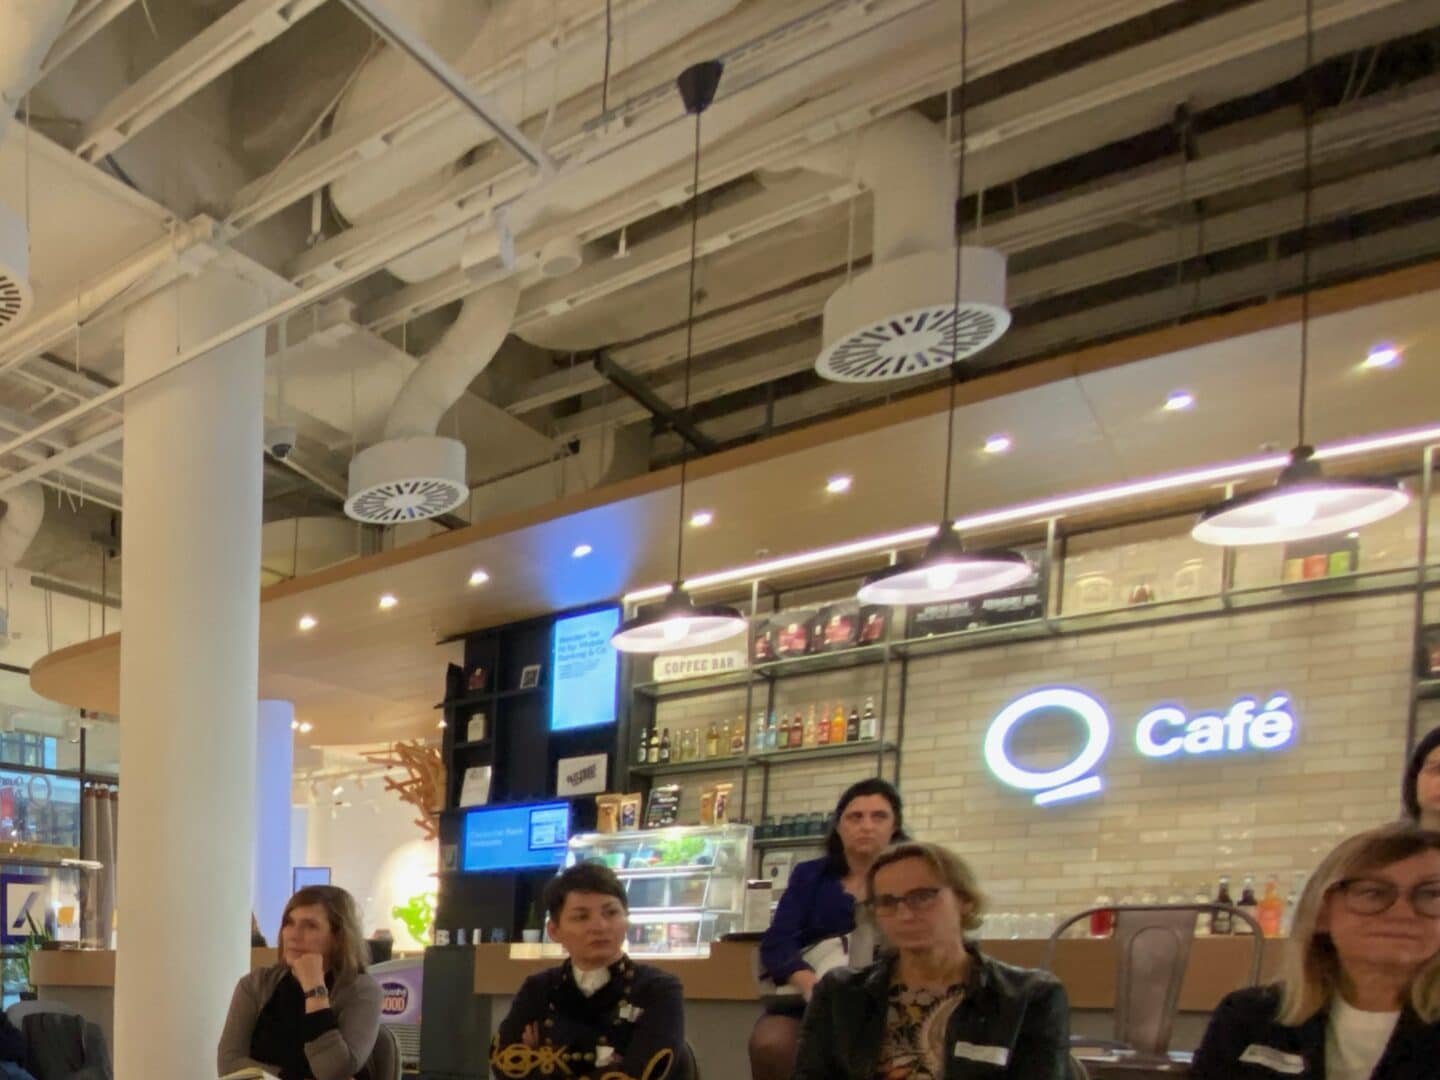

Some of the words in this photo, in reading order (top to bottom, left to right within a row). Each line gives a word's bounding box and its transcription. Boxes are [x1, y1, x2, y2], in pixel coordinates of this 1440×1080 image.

[664, 659, 708, 674] COFFEE
[711, 657, 734, 670] BAR
[1135, 695, 1294, 757] Café
